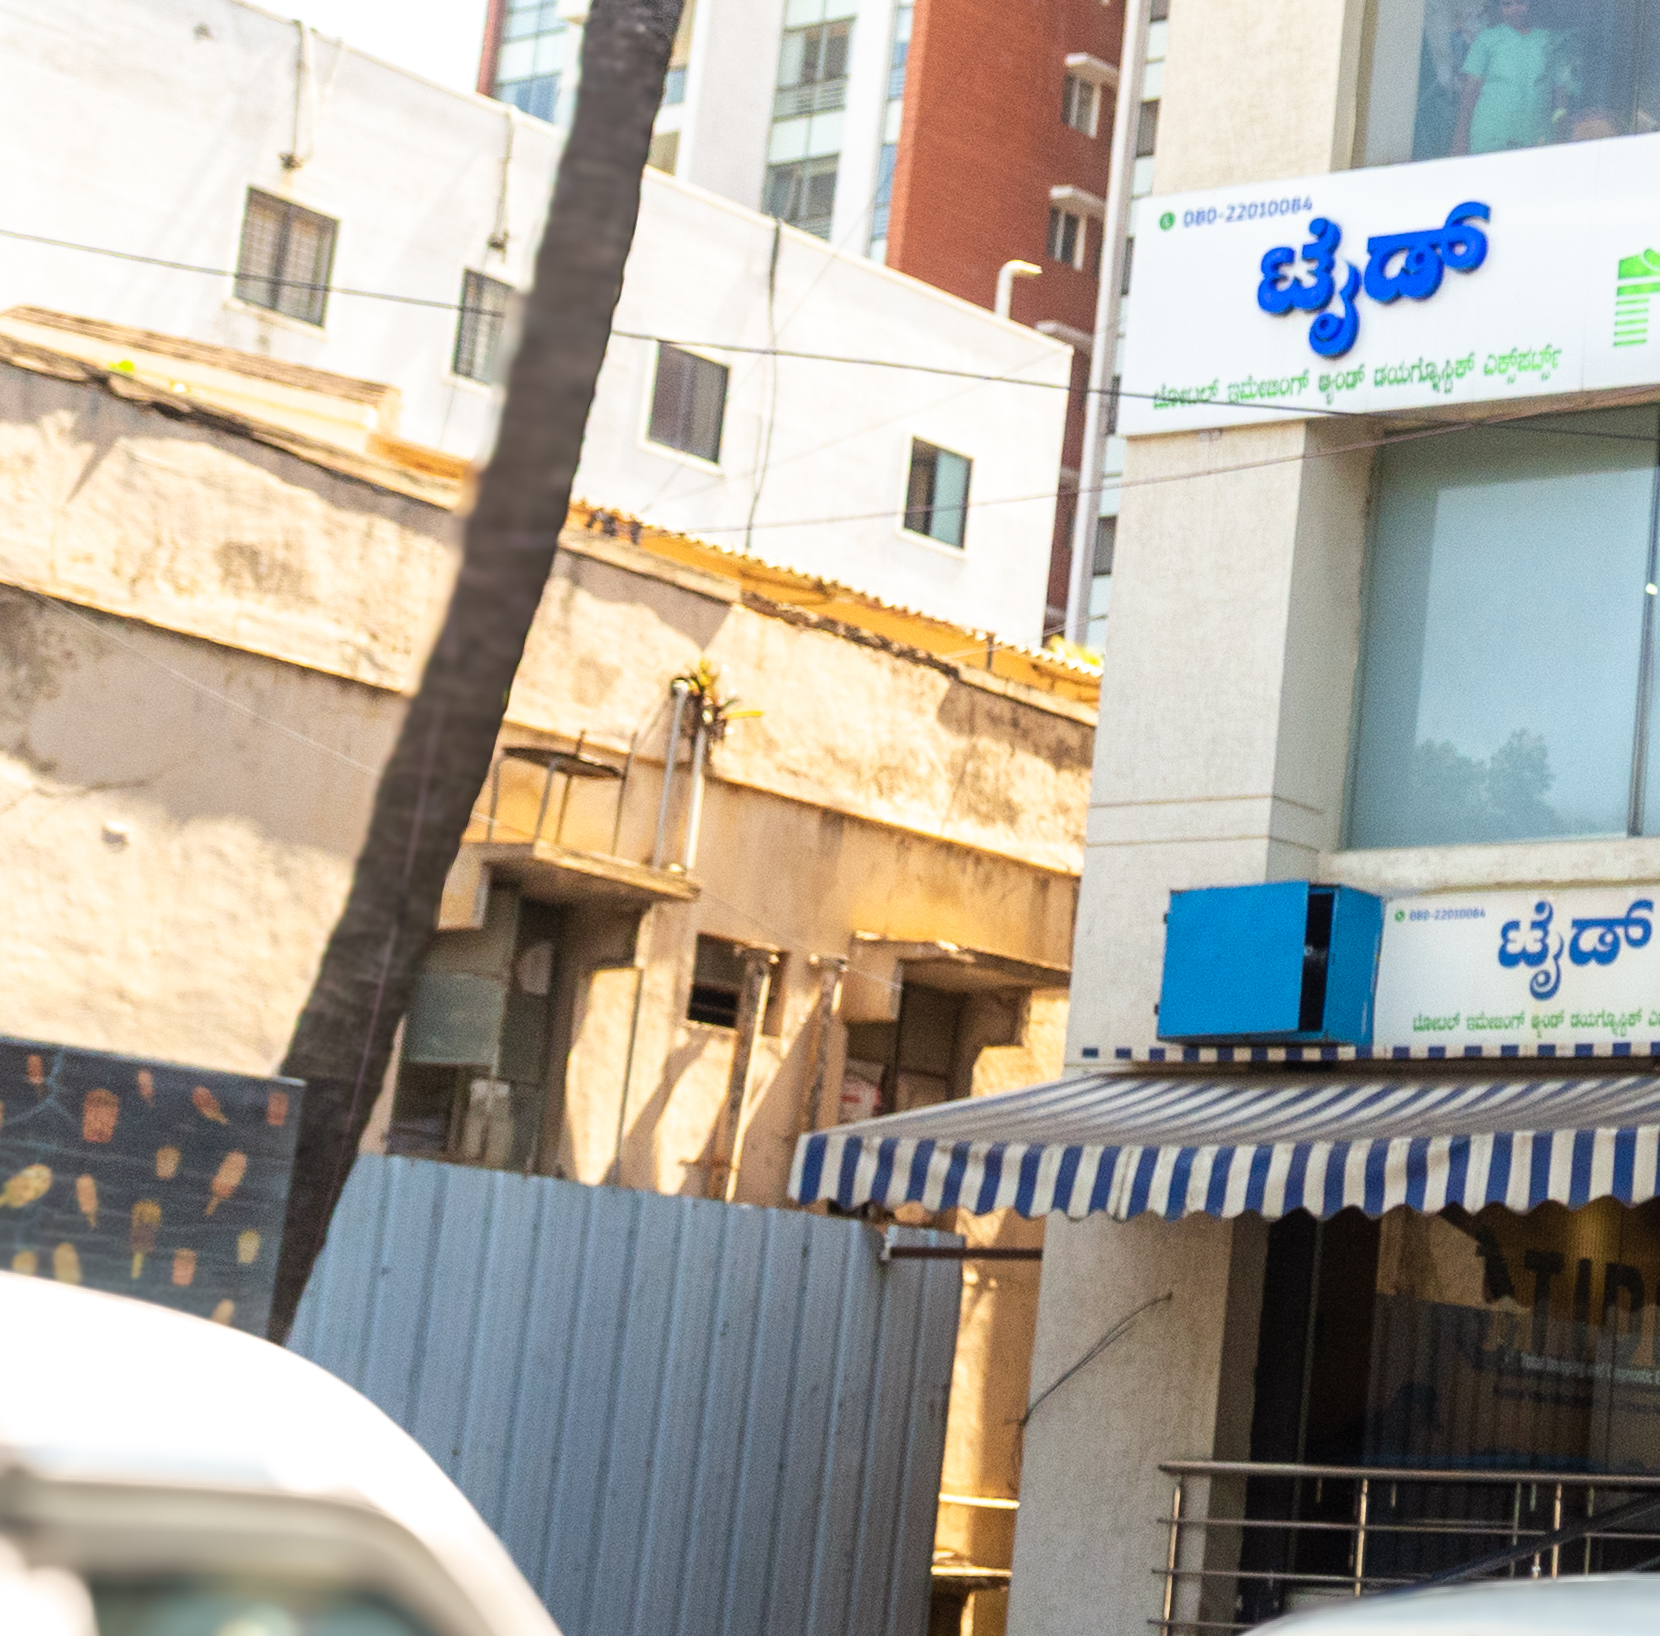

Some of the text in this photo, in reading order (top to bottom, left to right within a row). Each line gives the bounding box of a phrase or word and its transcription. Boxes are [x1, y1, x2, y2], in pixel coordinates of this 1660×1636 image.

[1183, 196, 1313, 228] 080-22010084
[1257, 200, 1492, 359] ಟೈಡ್
[1498, 899, 1655, 1001] ಟೈಡ್
